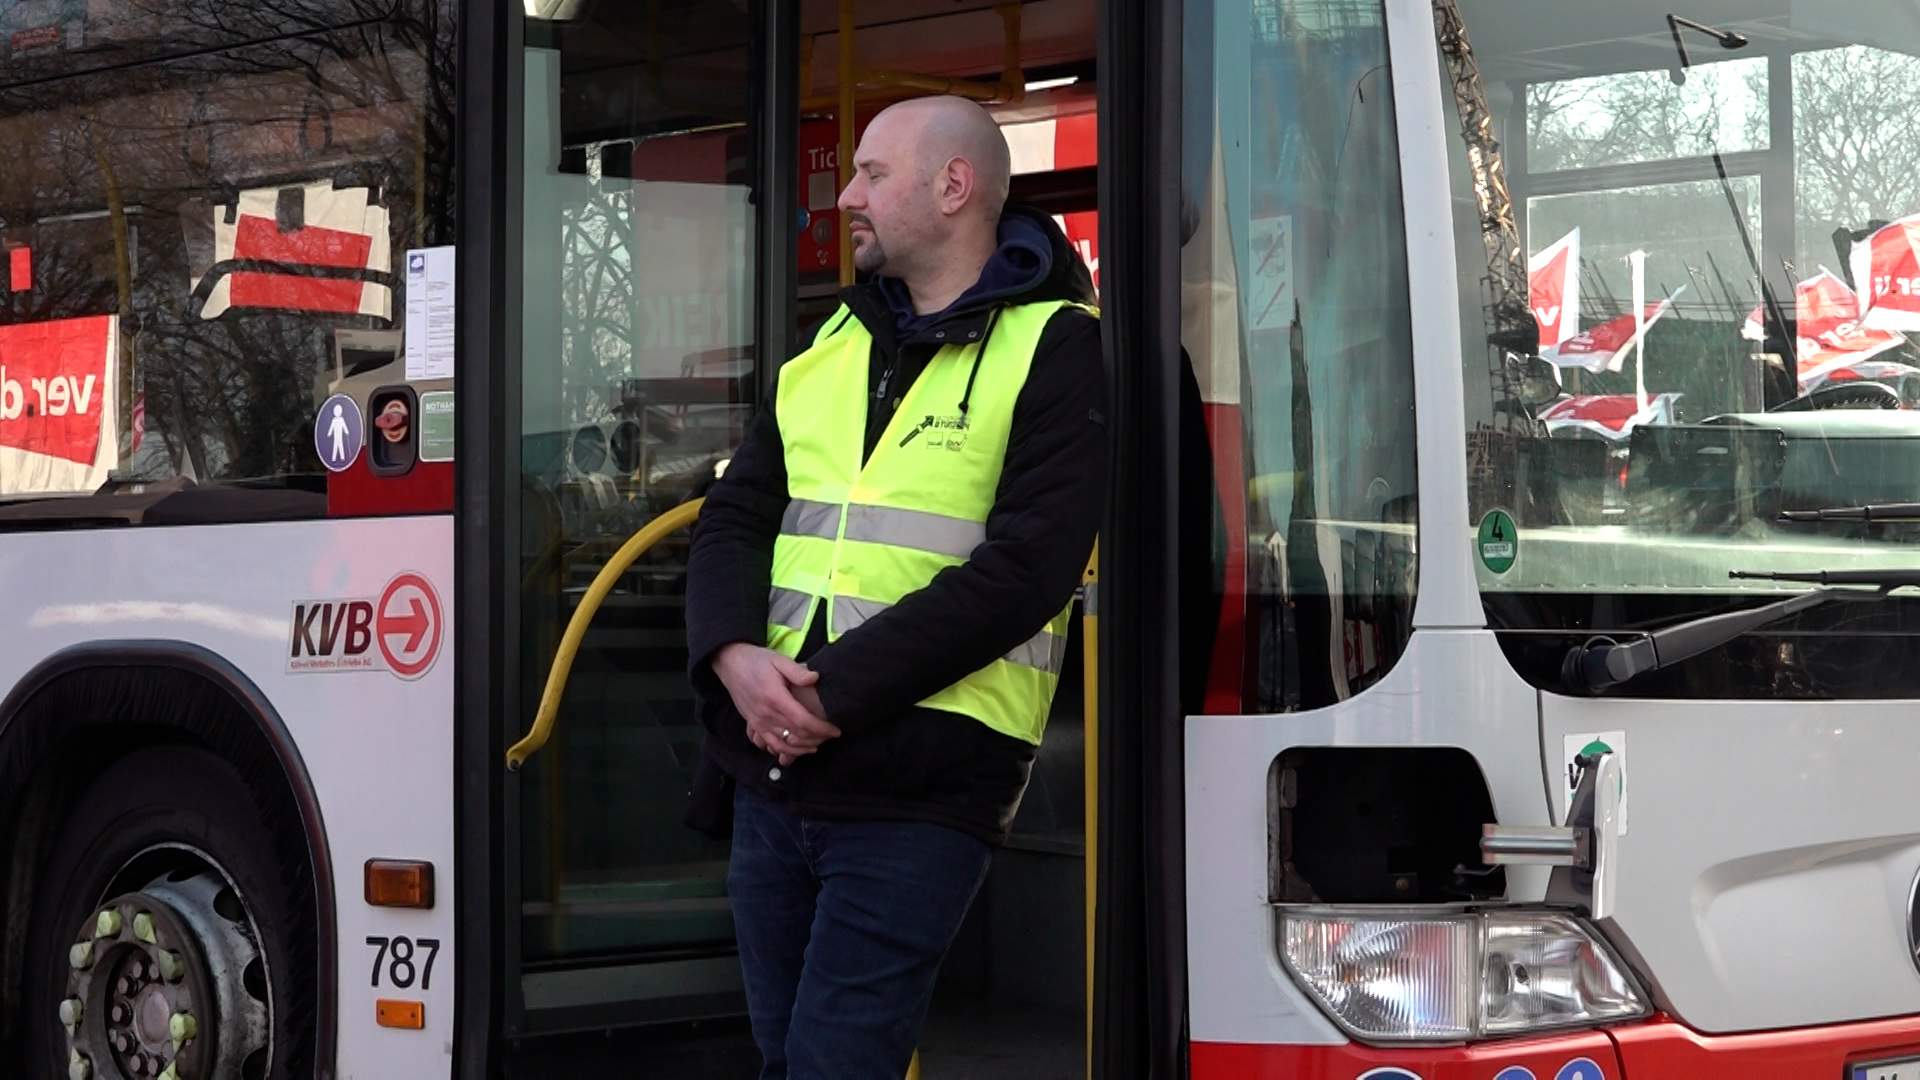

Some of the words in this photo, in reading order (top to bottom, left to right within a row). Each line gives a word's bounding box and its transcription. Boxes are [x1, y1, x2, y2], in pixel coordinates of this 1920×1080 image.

[1491, 513, 1504, 541] 4
[291, 601, 373, 657] KVB
[366, 935, 440, 990] 787
